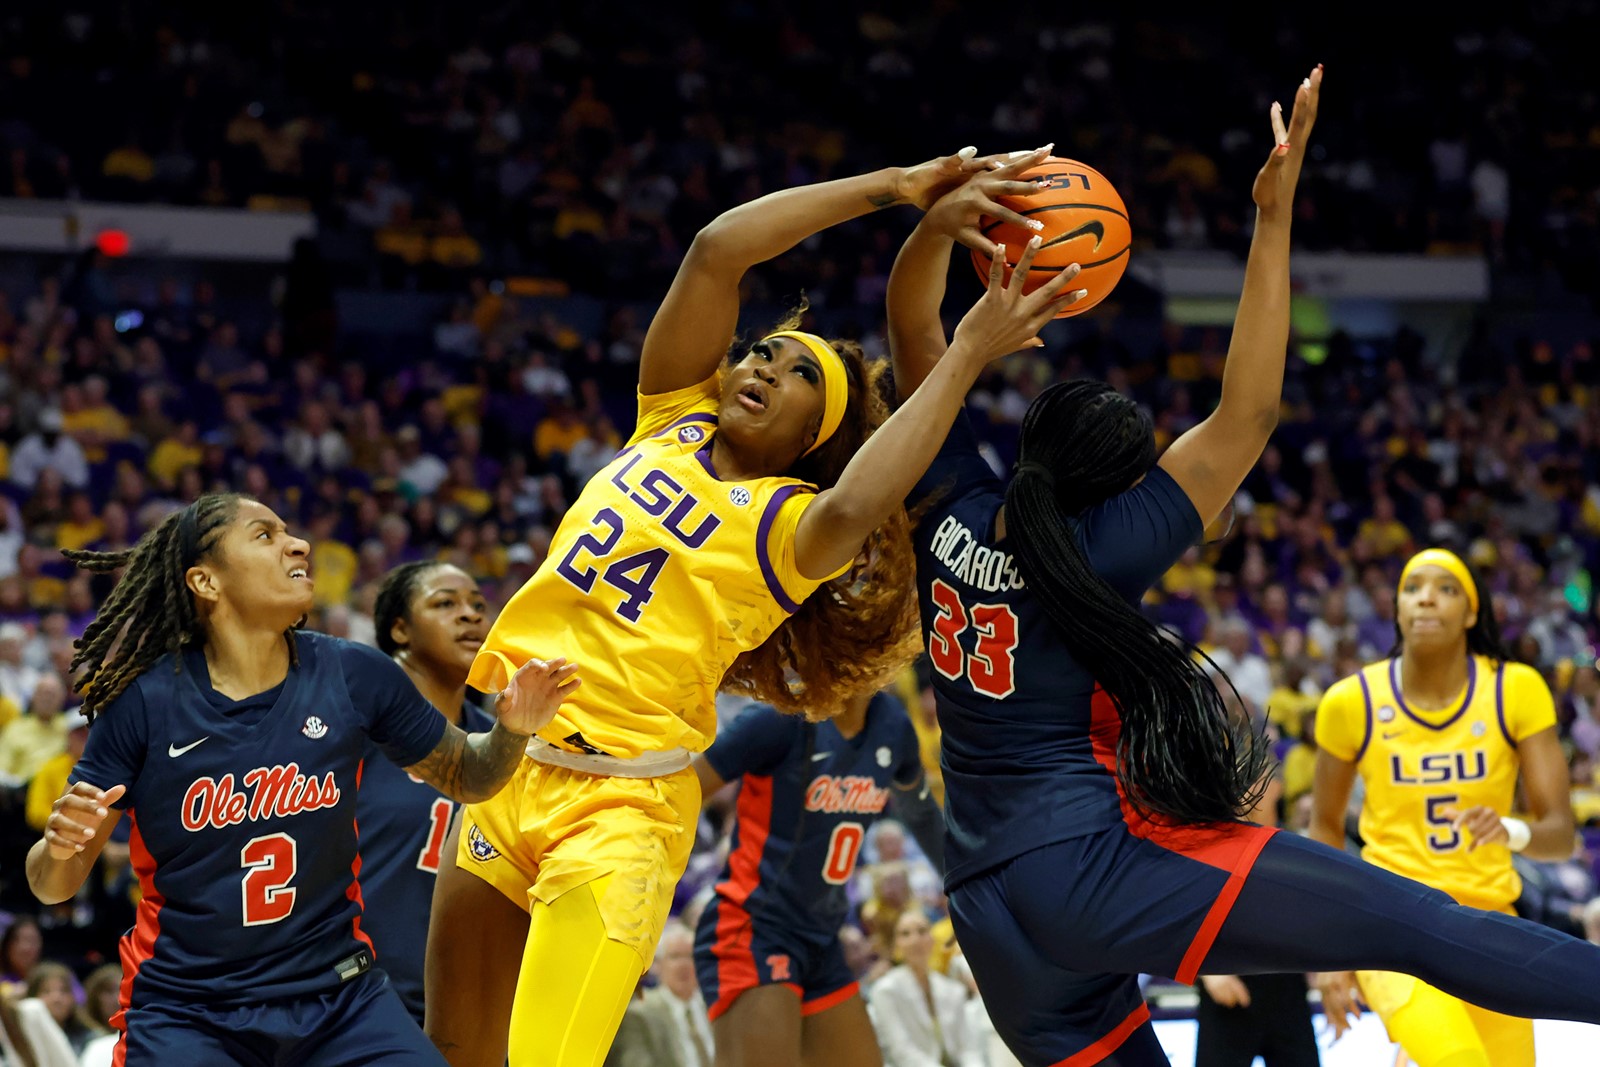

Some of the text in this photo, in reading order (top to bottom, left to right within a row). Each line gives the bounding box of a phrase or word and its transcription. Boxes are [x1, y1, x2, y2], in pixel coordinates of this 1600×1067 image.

[611, 453, 722, 549] LSU
[730, 487, 750, 506] SEC
[556, 507, 672, 624] 24
[929, 578, 1019, 700] 33
[181, 762, 340, 832] Ole Miss
[1391, 751, 1487, 785] LSU
[822, 821, 864, 885] 0
[1425, 794, 1461, 852] 5
[241, 831, 297, 927] 2
